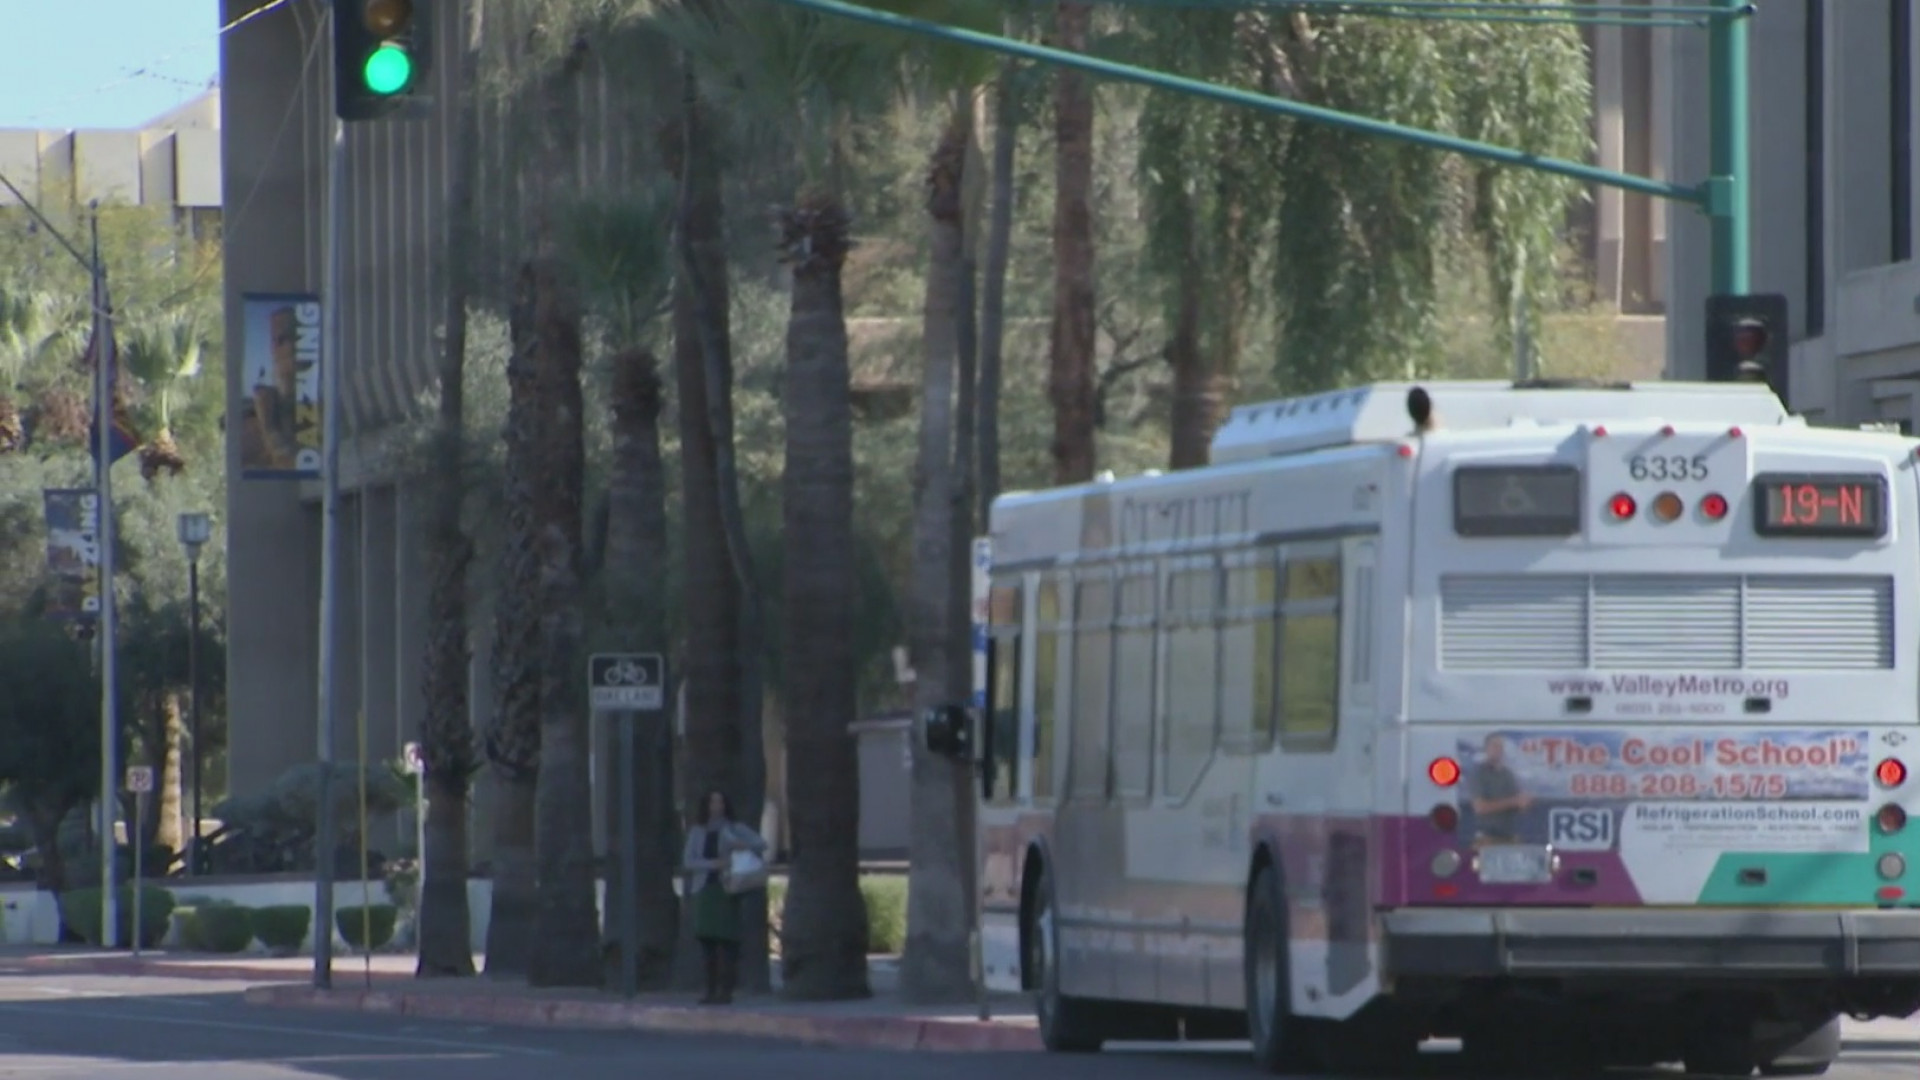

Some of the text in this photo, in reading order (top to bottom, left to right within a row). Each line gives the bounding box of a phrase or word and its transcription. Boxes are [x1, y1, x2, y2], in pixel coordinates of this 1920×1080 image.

[295, 302, 320, 470] DAZZLING
[1629, 456, 1709, 481] 6335
[1780, 485, 1863, 525] 19-N
[1548, 676, 1789, 698] www.ValleyMetro.org
[1621, 739, 1701, 766] Cool
[1570, 774, 1787, 798] 888-208-1575
[1553, 810, 1610, 842] RSI
[1636, 806, 1860, 825] RefrigerationSchool.com
